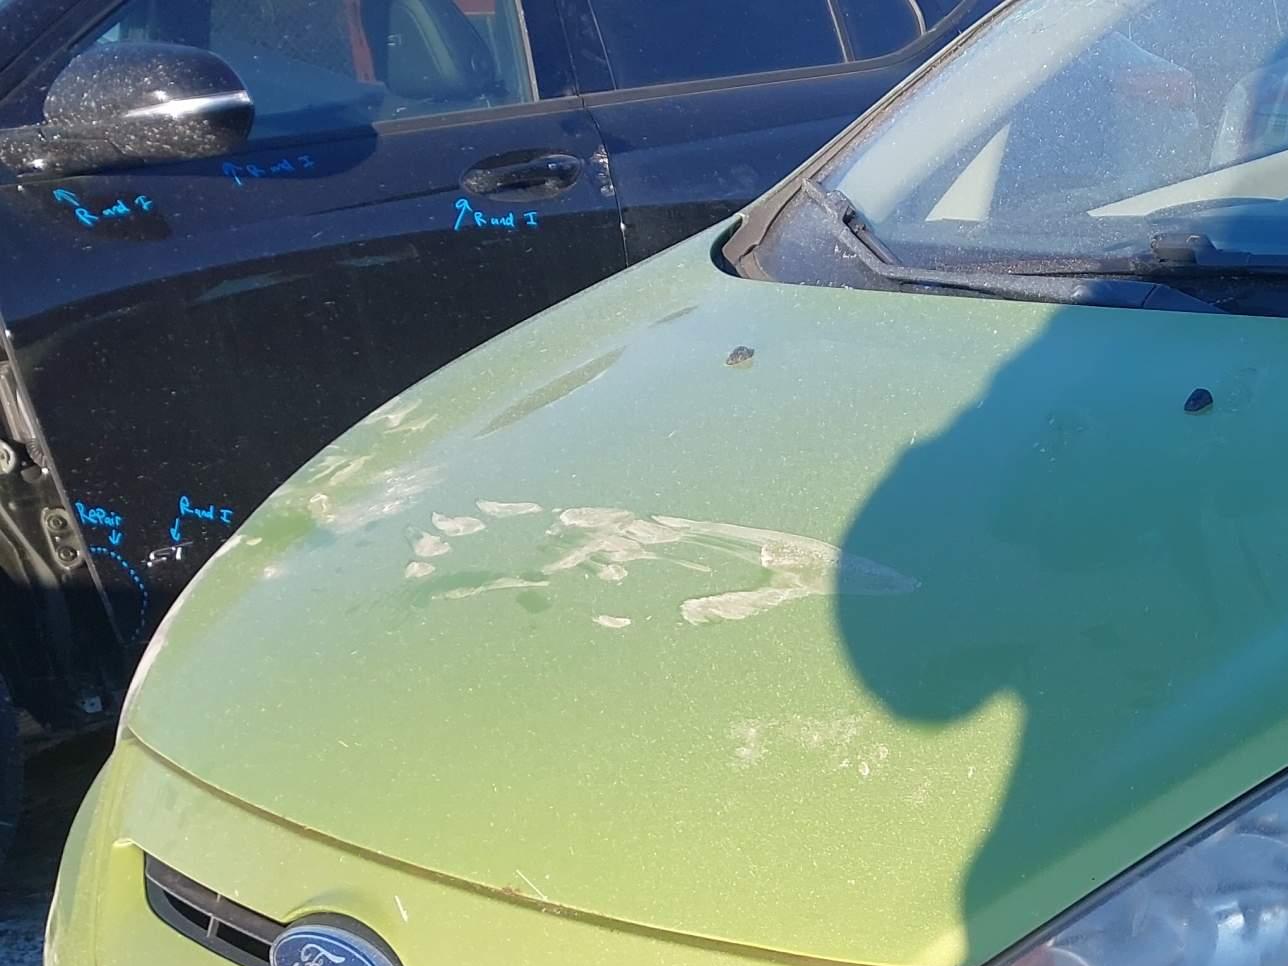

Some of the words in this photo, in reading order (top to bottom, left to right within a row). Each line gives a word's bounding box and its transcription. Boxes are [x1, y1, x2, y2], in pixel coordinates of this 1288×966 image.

[75, 208, 99, 226] R
[474, 211, 487, 226] R
[490, 212, 515, 227] and
[523, 211, 538, 225] I
[179, 495, 193, 515] R
[220, 509, 233, 523] I
